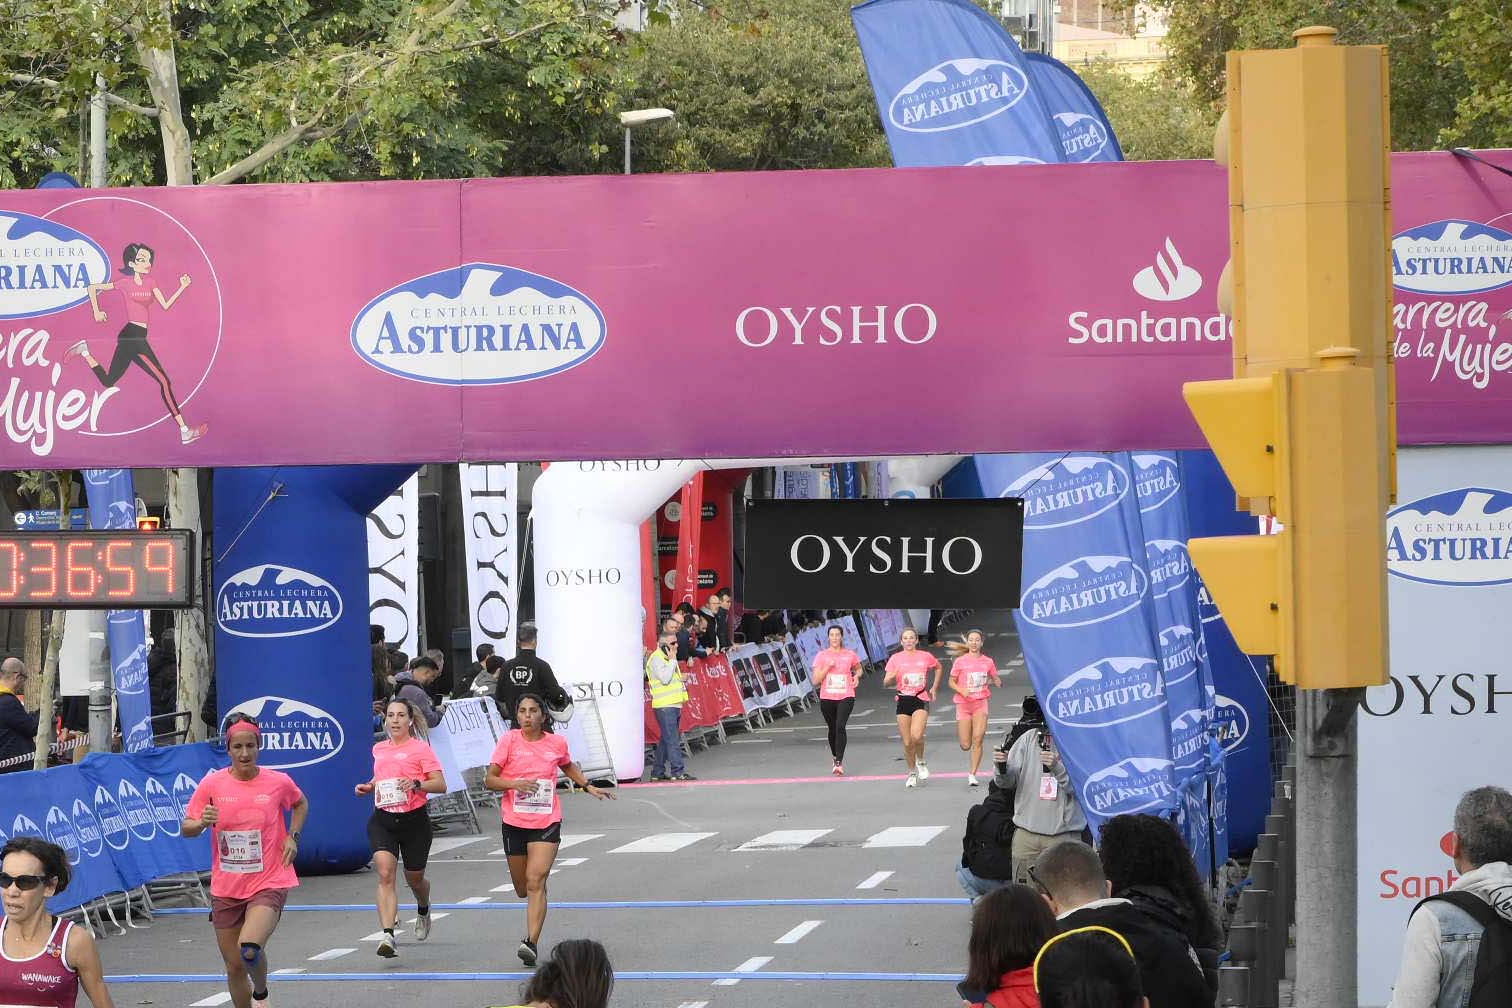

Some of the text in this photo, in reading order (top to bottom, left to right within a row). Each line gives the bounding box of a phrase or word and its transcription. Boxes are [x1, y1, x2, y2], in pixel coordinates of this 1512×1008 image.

[14, 247, 87, 258] LECHERA
[410, 304, 578, 319] CENTRAL LECHERA
[735, 303, 937, 347] OYSHO
[1392, 300, 1489, 330] arrera
[371, 310, 586, 355] ASTURIANA
[1068, 310, 1233, 345] Santand
[1417, 331, 1436, 358] la
[1430, 325, 1512, 389] Muje
[1415, 521, 1482, 533] CENTRAL
[789, 534, 984, 576] OYSHO
[546, 567, 622, 587] OYSHO
[233, 589, 328, 598] CENTRAL LECHERA
[220, 594, 334, 622] ASTURIANA
[576, 680, 624, 698] SHO
[1361, 671, 1512, 717] OYSH
[259, 731, 335, 750] URIANA
